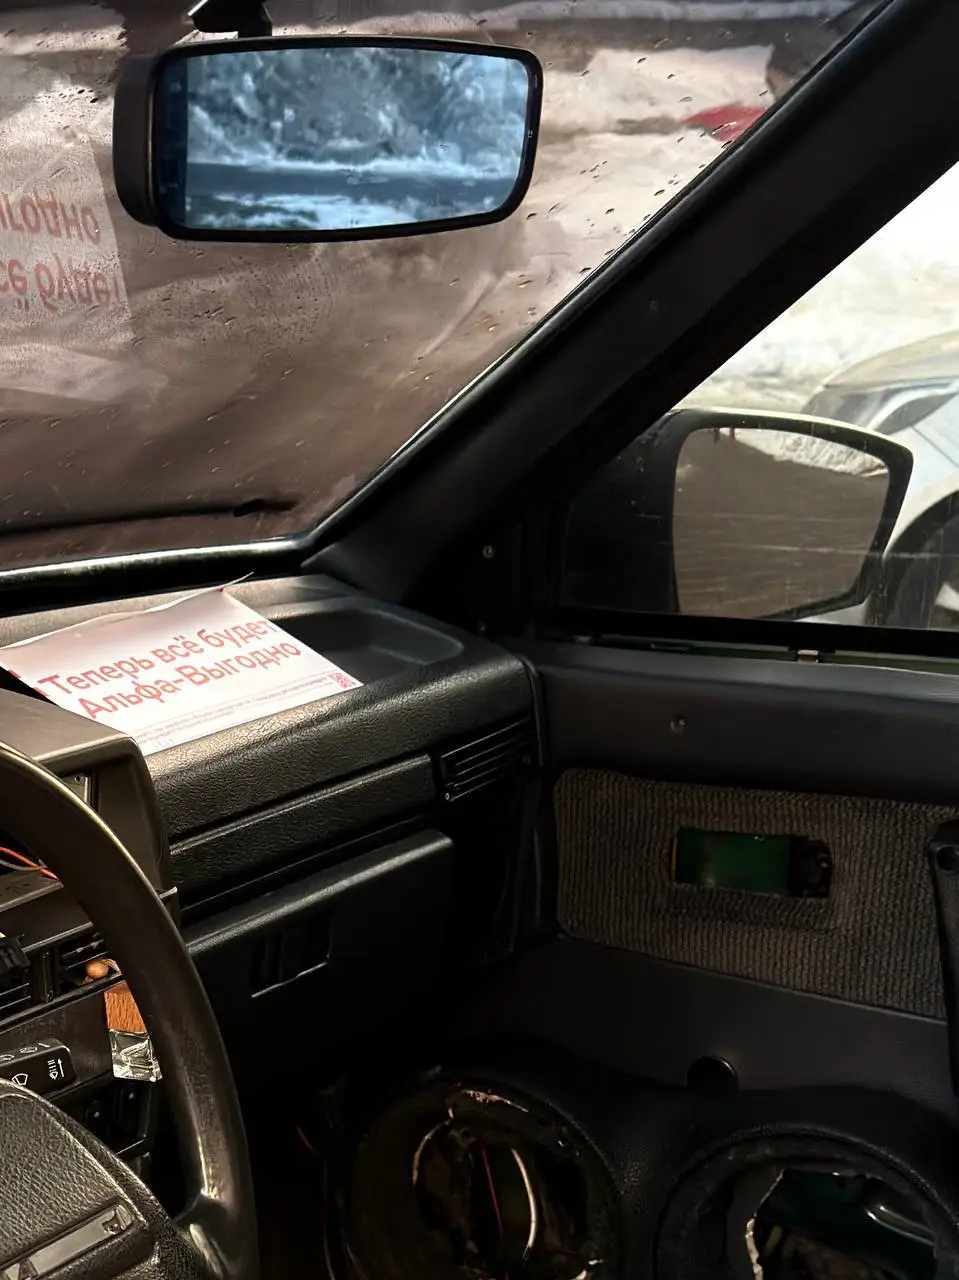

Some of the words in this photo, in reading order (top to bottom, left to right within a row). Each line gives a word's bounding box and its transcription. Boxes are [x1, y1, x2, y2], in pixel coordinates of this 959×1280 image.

[37, 656, 155, 695] Теперь
[151, 635, 205, 664] всё
[196, 618, 279, 650] будет
[77, 642, 302, 720] Альфа-Выгодно
